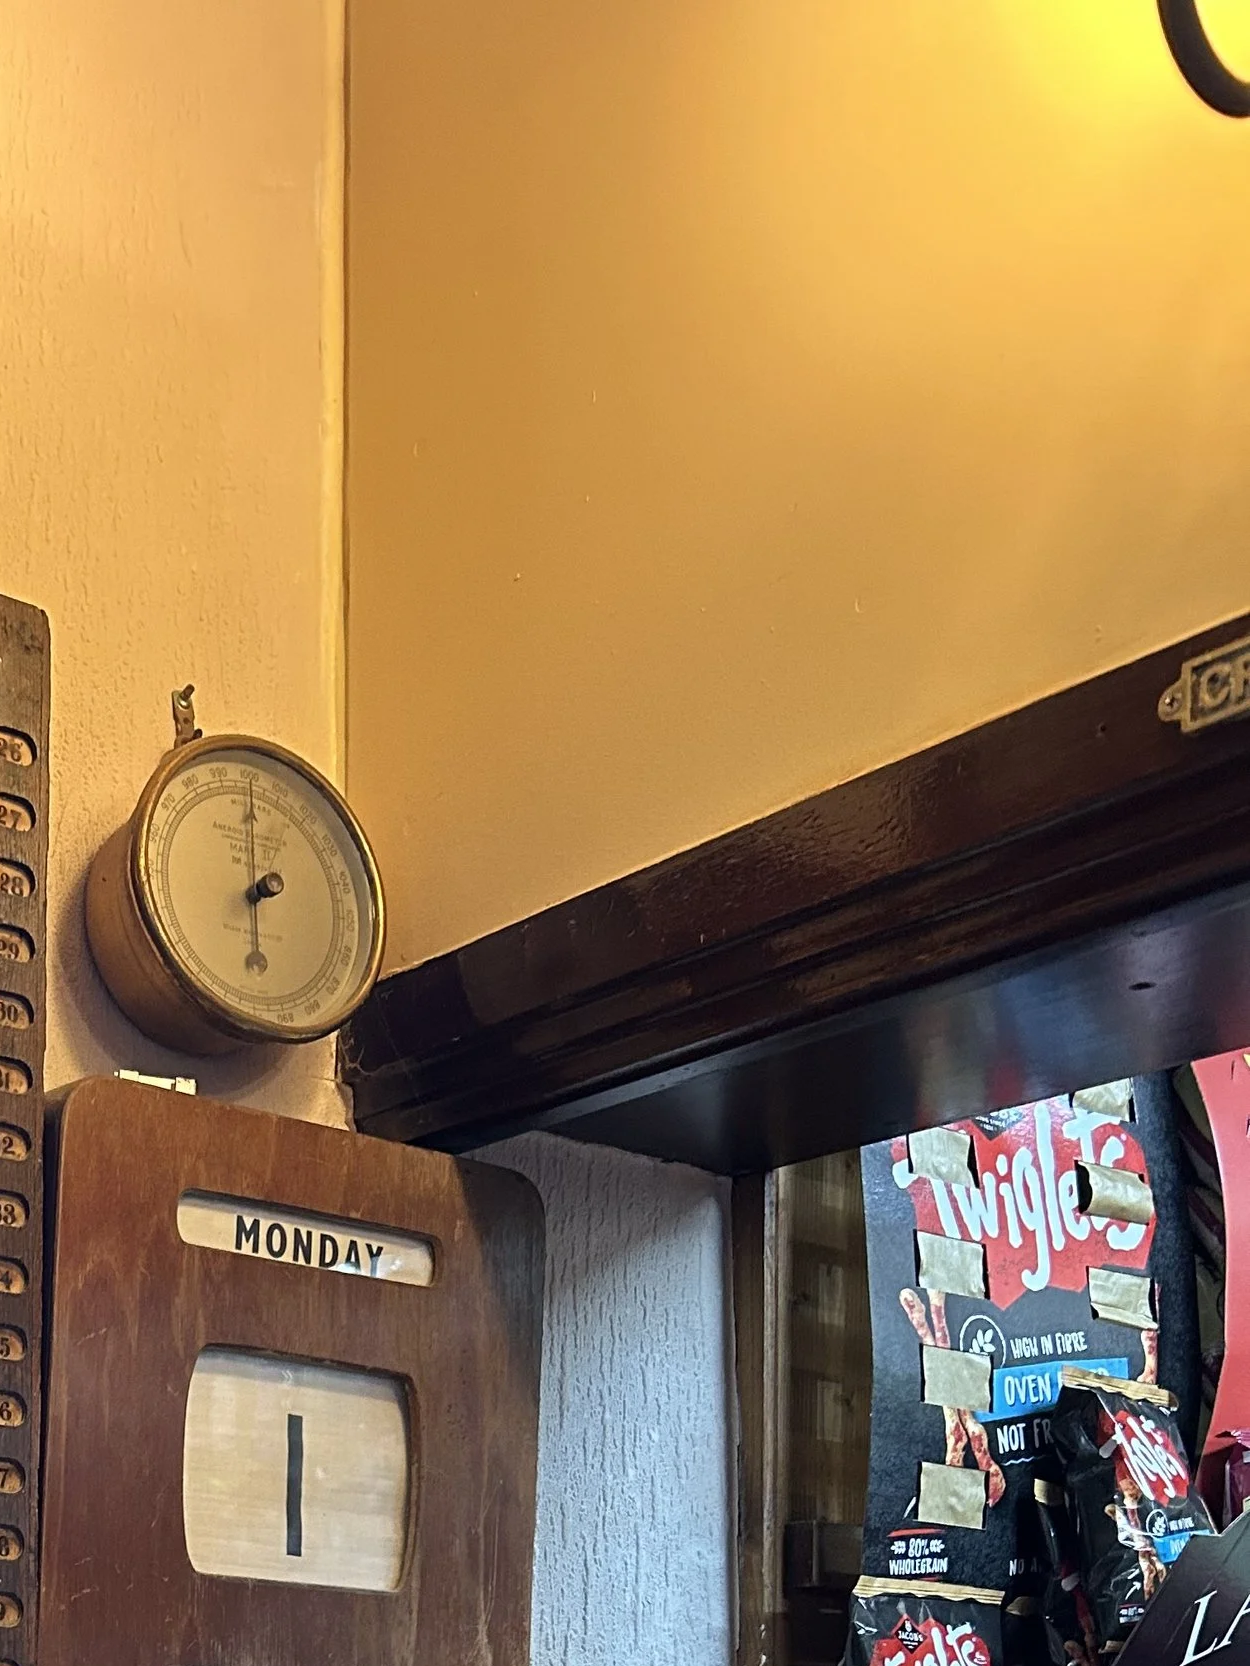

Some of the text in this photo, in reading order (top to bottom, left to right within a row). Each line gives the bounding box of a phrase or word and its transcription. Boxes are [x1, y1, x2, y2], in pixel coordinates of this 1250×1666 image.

[0, 872, 24, 896] 28
[235, 1215, 386, 1278] MONDAY
[1009, 1330, 1088, 1360] HIGH IN FIBRE
[1003, 1376, 1050, 1407] OVEN
[995, 1422, 1027, 1456] NOT
[907, 1538, 930, 1559] 80%
[889, 1556, 948, 1577] WHOLEGRAIN
